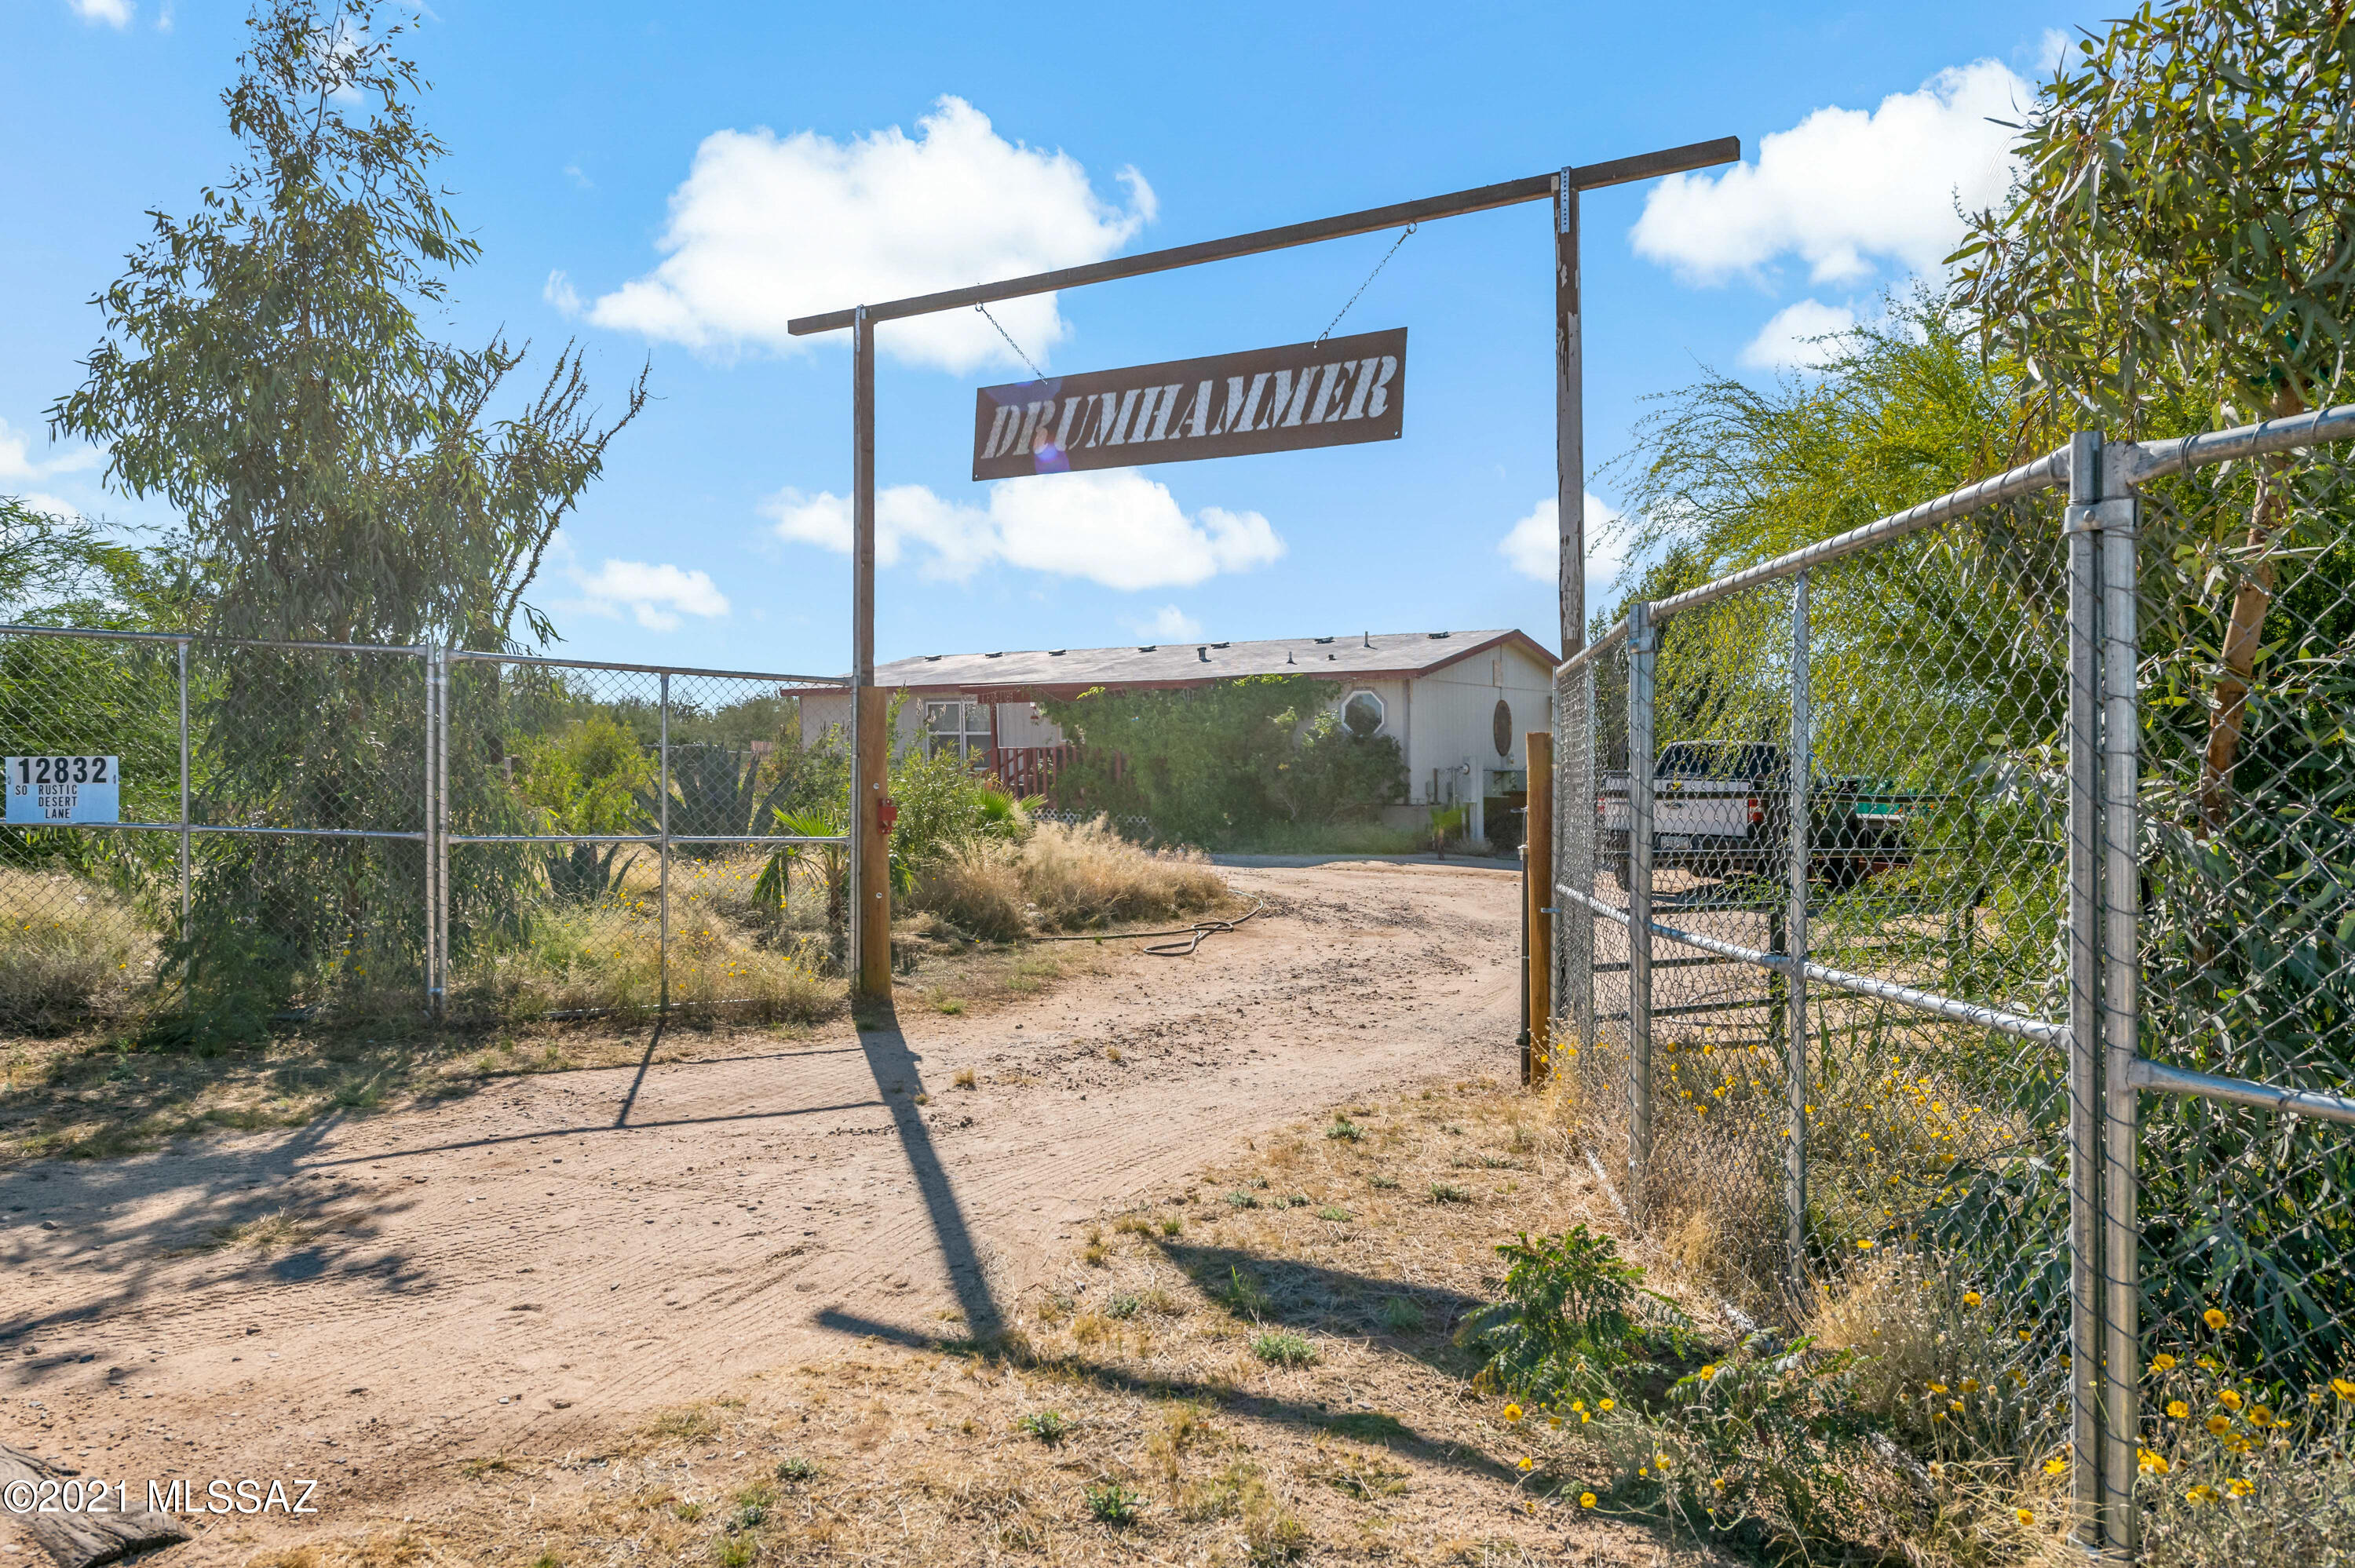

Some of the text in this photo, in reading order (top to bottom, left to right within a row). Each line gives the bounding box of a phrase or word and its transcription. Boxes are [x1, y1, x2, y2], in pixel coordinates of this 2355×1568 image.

[980, 355, 1397, 459] DRUMHAMMER
[18, 757, 107, 783] 12832
[15, 785, 77, 795] SO RUSTIC
[38, 797, 77, 807] DESERT
[45, 808, 70, 819] LANE
